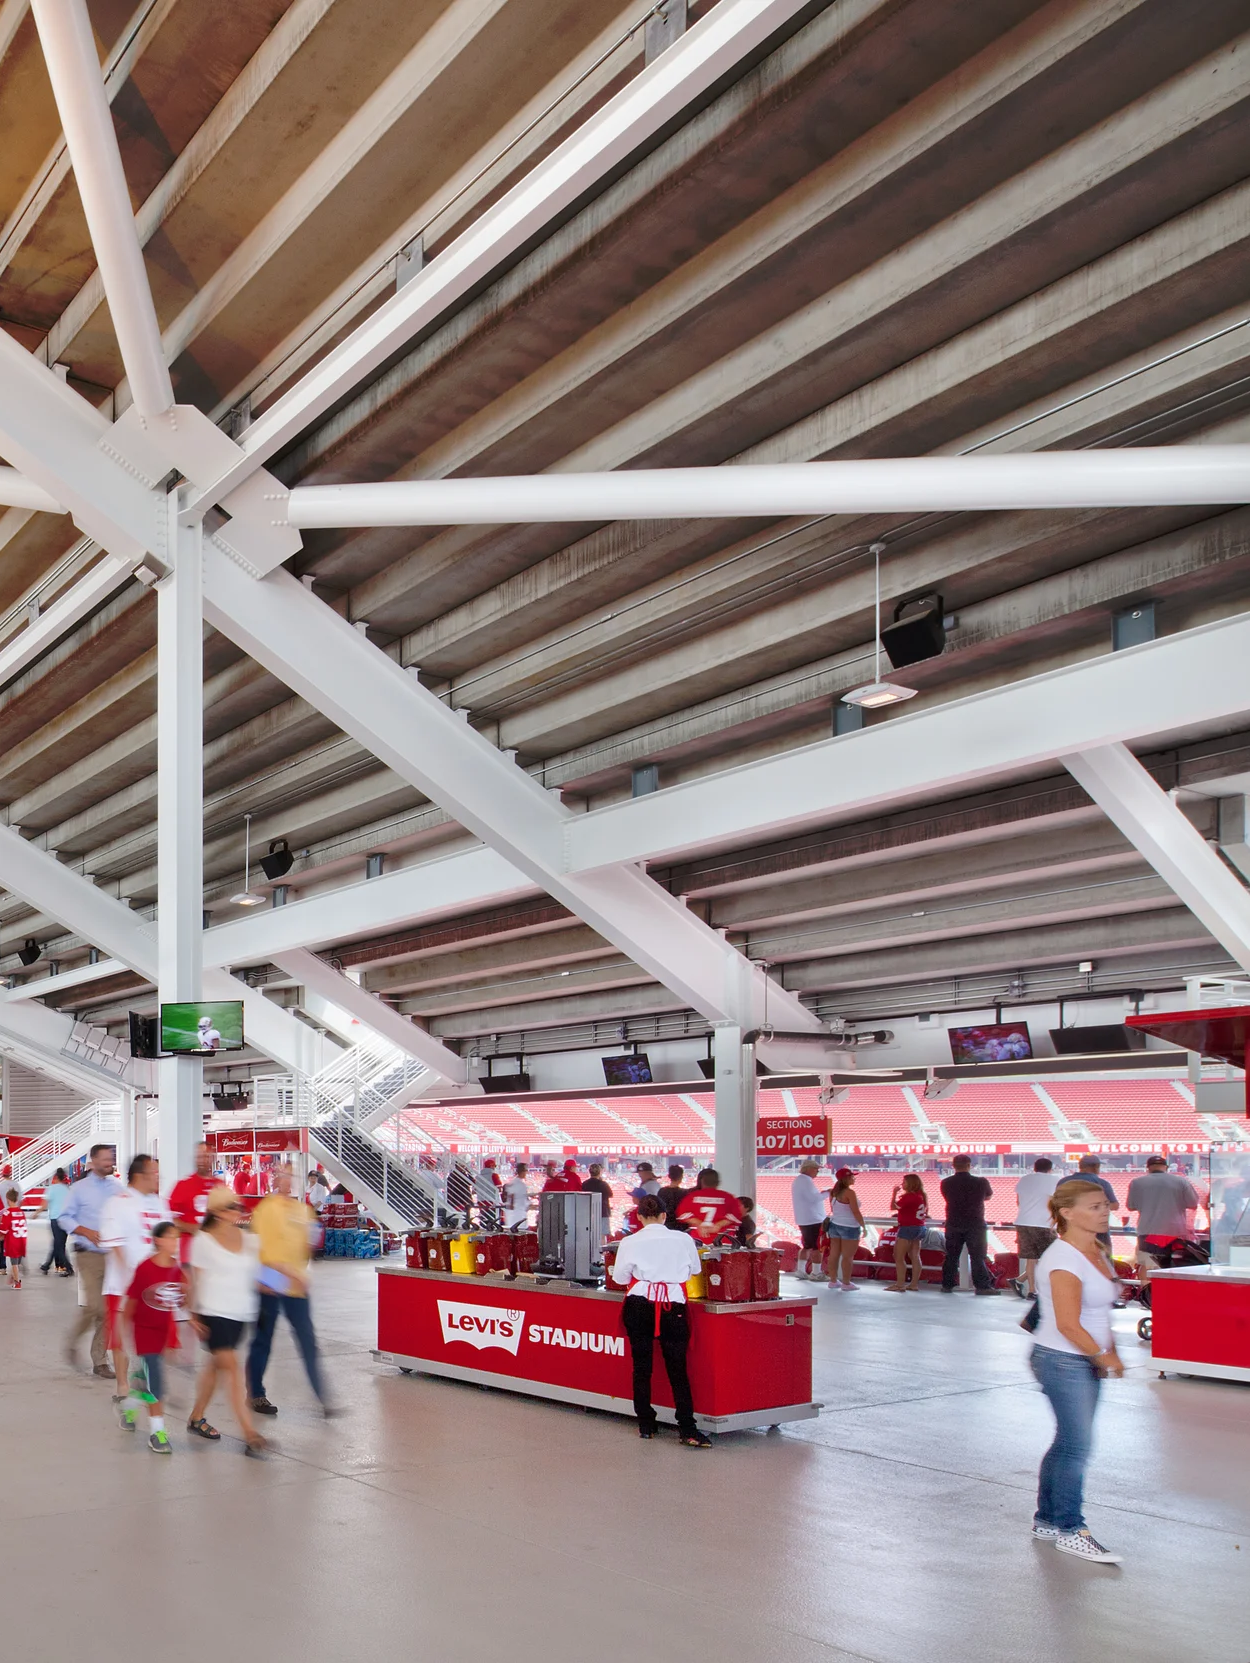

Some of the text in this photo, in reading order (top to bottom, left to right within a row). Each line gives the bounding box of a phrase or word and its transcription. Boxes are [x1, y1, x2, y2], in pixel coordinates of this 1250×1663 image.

[766, 1119, 812, 1130] SECTIONS
[756, 1135, 787, 1149] 107
[792, 1134, 825, 1149] 106
[577, 1145, 623, 1154] WELCOME
[625, 1145, 637, 1154] TO
[674, 1145, 715, 1154] STADIUM
[859, 1144, 876, 1153] TO
[934, 1144, 997, 1153] STADIUM
[1088, 1144, 1162, 1153] WELCOME
[1167, 1143, 1188, 1152] TO
[700, 1206, 717, 1227] 7
[528, 1324, 625, 1357] STADIUM
